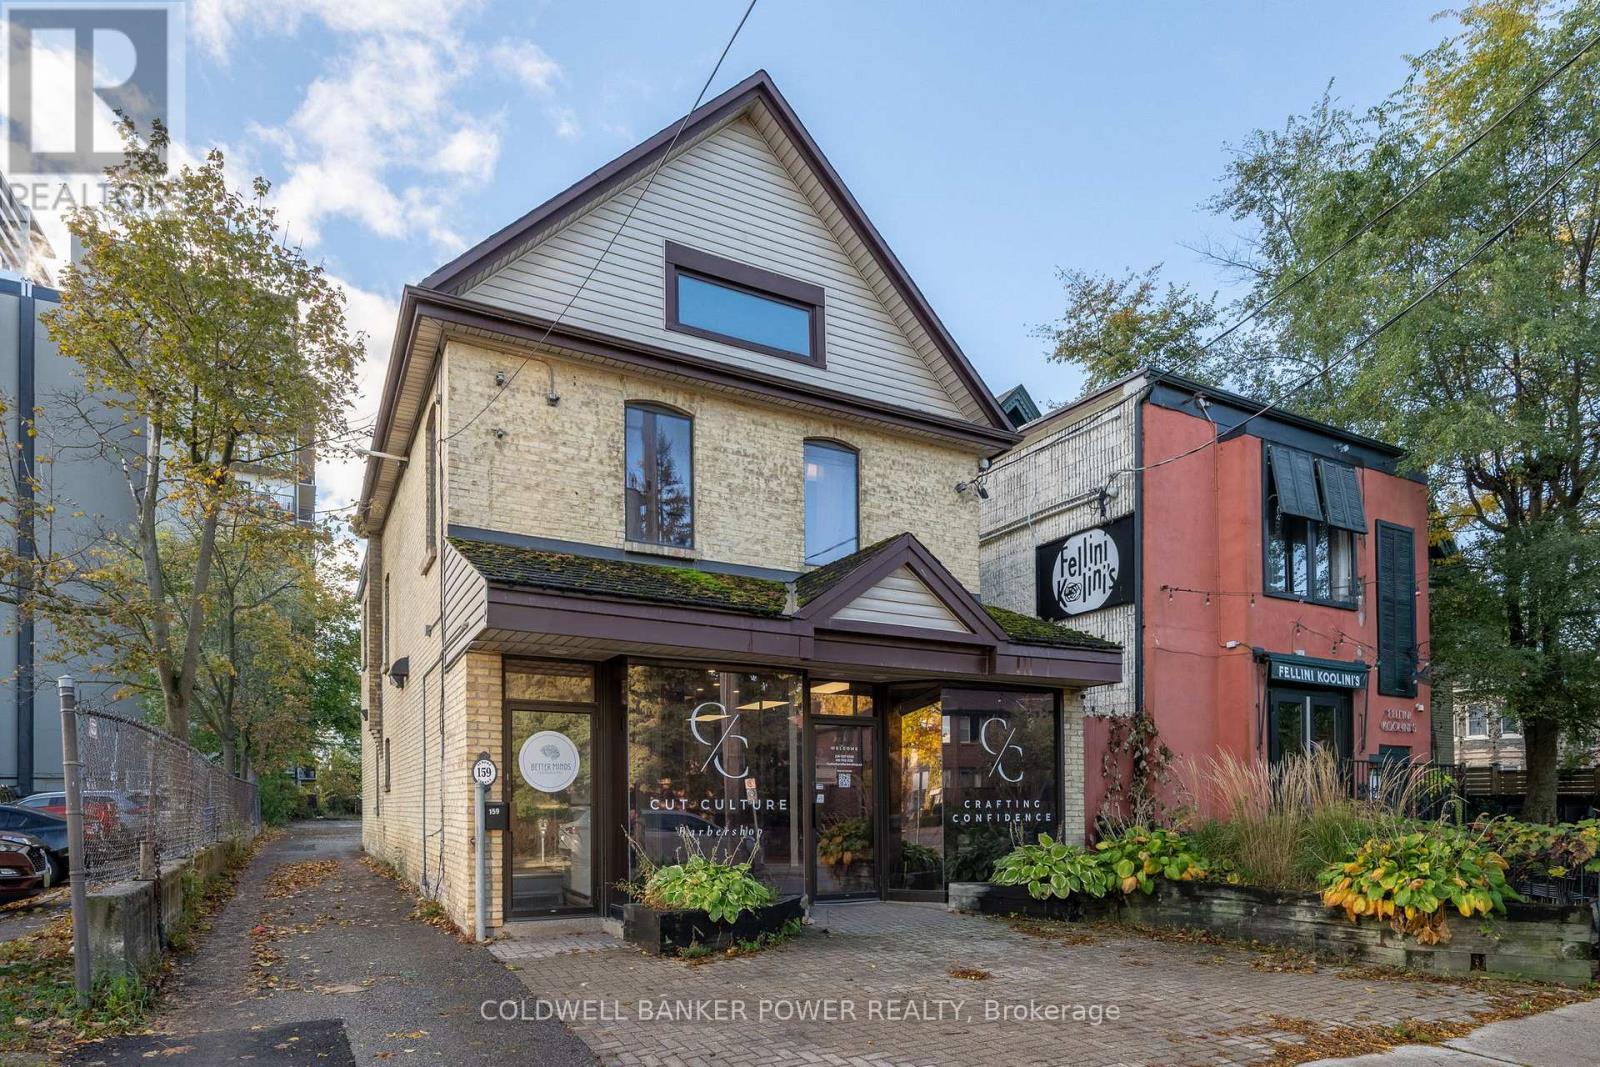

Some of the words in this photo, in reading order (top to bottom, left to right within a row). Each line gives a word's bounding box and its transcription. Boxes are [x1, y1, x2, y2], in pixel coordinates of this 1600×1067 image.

[1060, 530, 1108, 578] Fellini
[1278, 665, 1315, 683] FELLINI
[1317, 670, 1361, 687] KOOLINI'S
[530, 762, 551, 771] BETTER
[552, 762, 572, 771] MINDS
[477, 767, 492, 778] 159
[650, 798, 689, 811] CUT
[700, 798, 788, 811] CULTURE
[964, 799, 1042, 809] CRAFTING
[488, 807, 500, 815] 159
[952, 812, 1052, 823] CONFIDENCE
[678, 824, 763, 837] Barbershop
